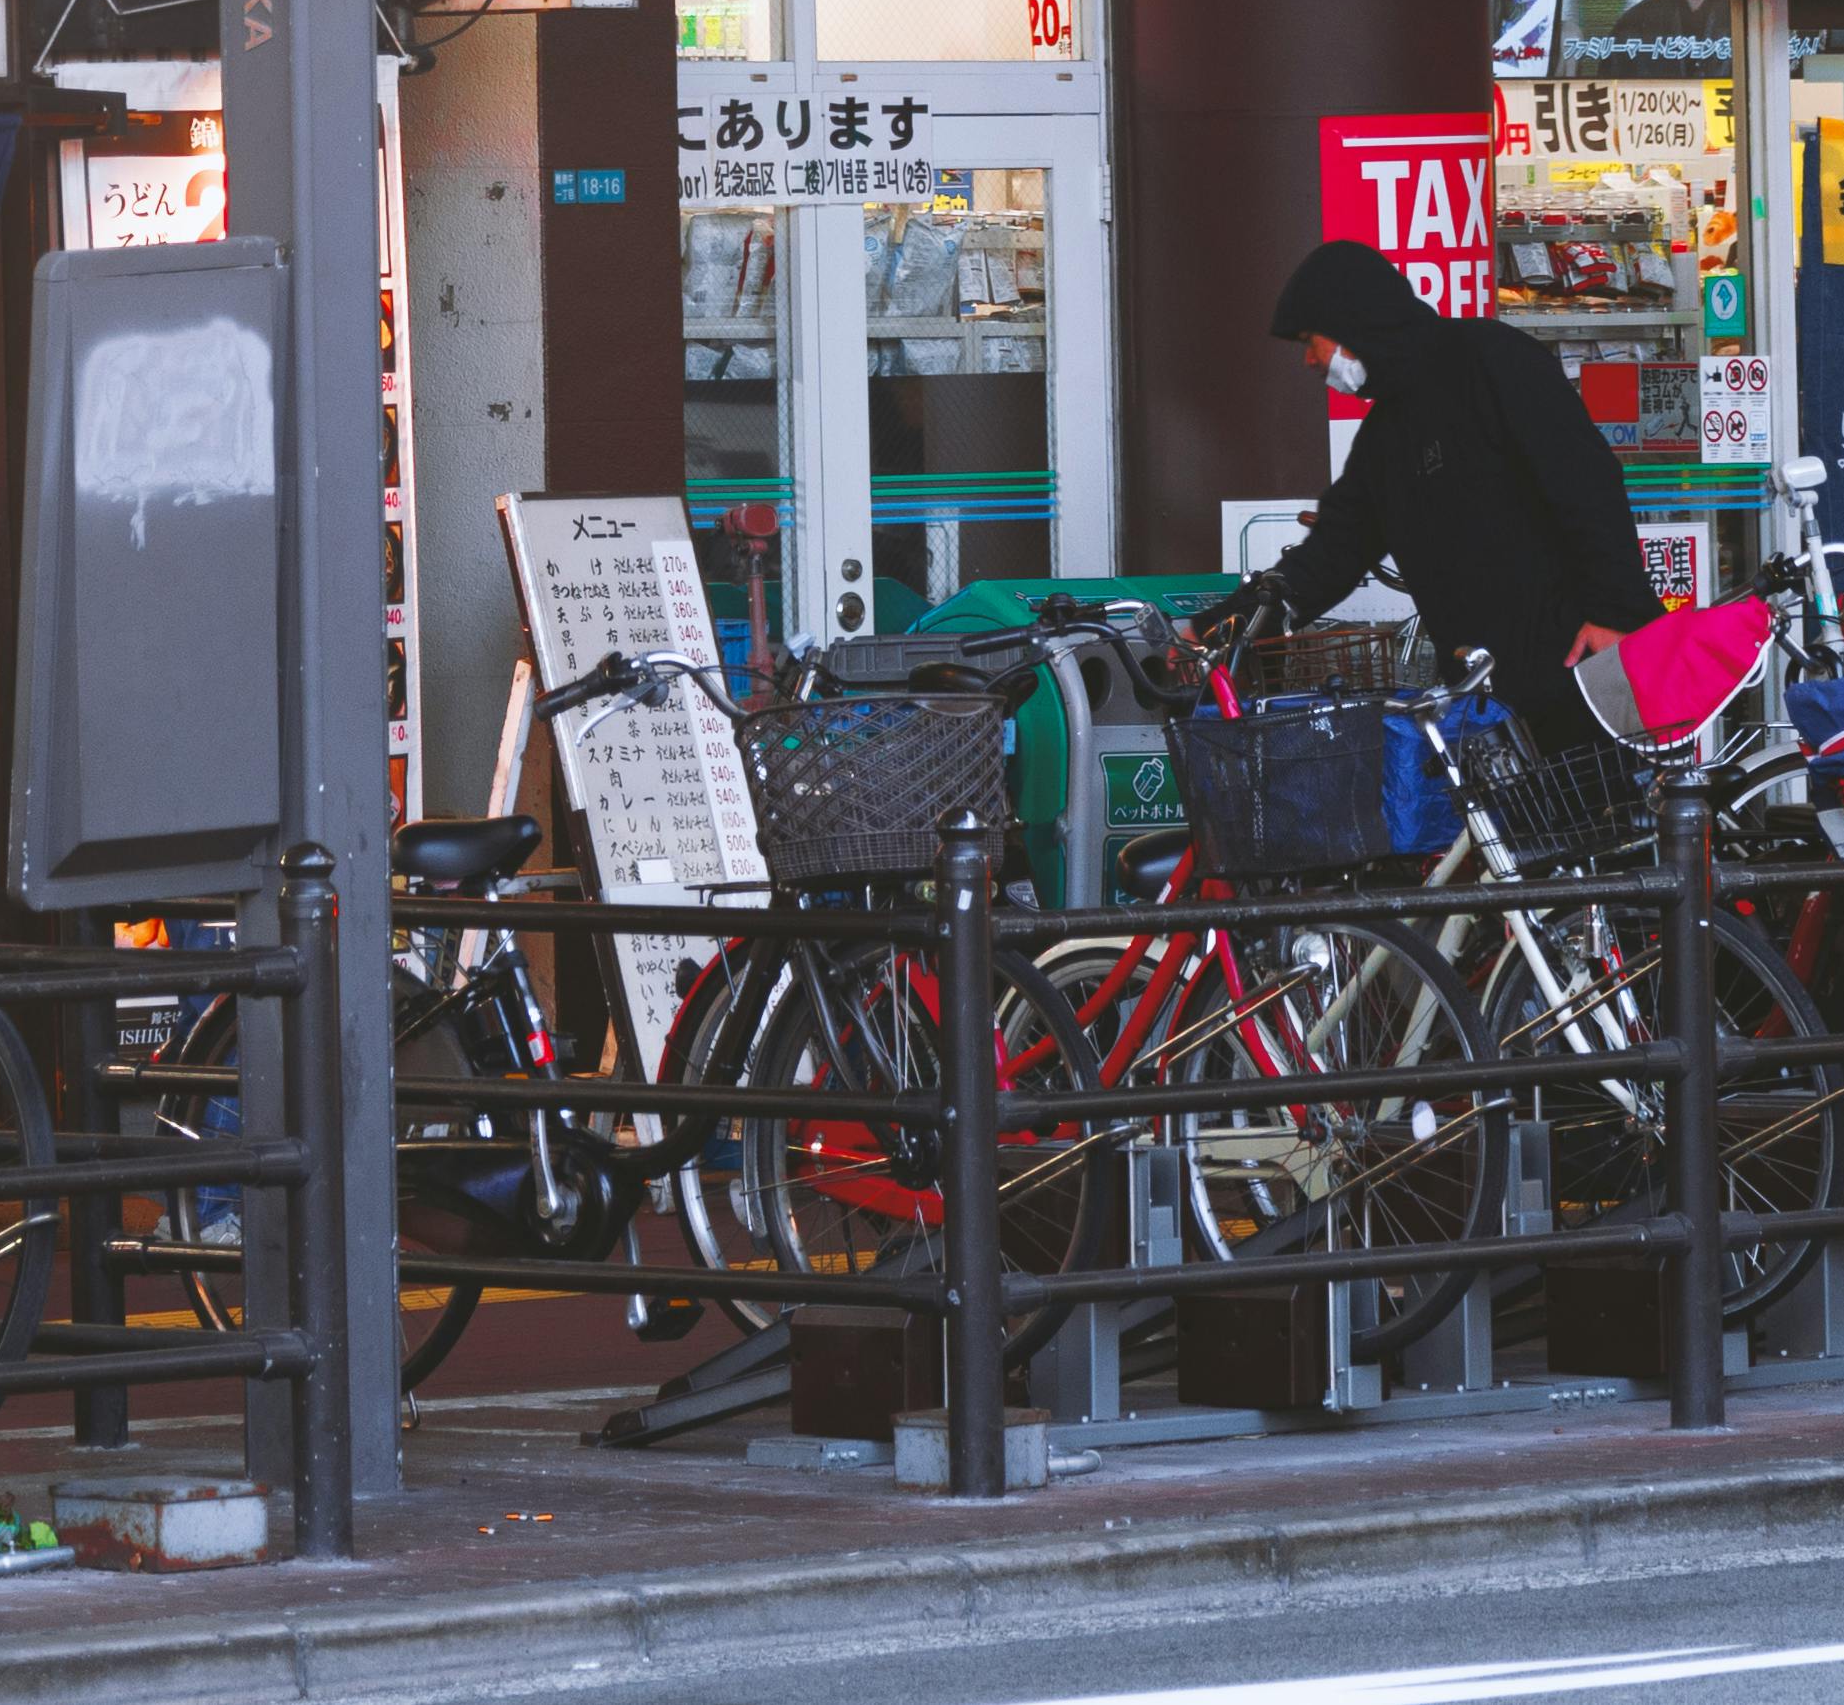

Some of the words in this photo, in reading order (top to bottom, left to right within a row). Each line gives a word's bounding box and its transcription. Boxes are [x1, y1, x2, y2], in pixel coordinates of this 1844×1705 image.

[583, 177, 621, 195] 18-16
[104, 183, 176, 218] うどん
[1361, 158, 1489, 251] TAX
[573, 514, 636, 541] メニュー
[1643, 538, 1694, 597] 募集
[588, 747, 645, 763] スタミナ
[600, 794, 655, 810] カレー
[117, 1027, 171, 1045] ISHIKI
